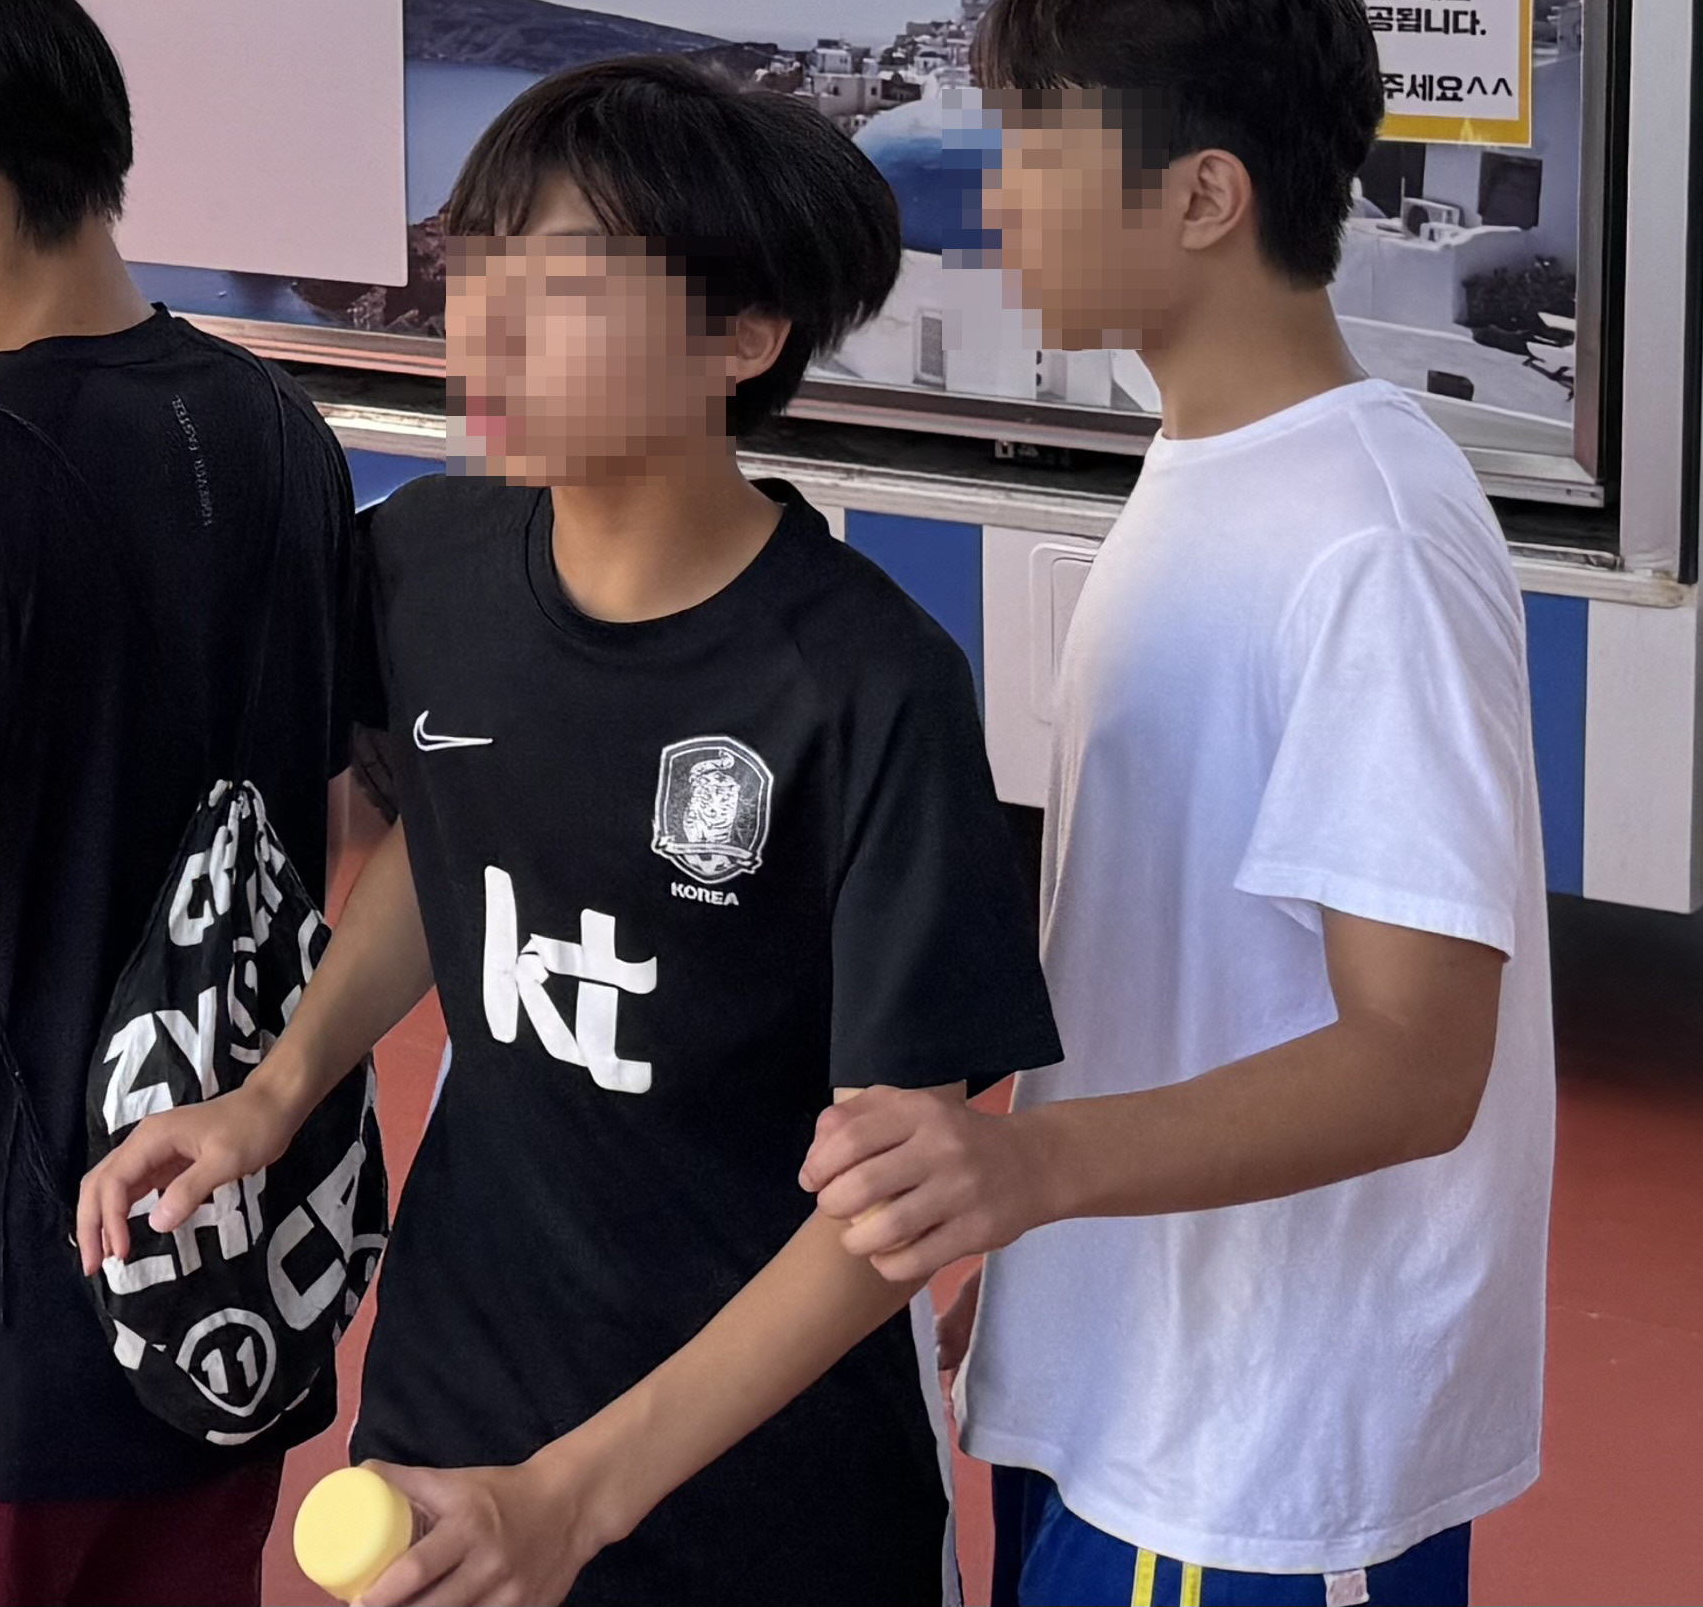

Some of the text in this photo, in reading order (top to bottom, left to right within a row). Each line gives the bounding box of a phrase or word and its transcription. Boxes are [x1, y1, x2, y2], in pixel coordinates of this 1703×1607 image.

[1367, 6, 1487, 36] 공됩니다.
[670, 881, 740, 906] KOREA
[483, 864, 658, 1094] kt
[200, 1334, 259, 1395] 11
